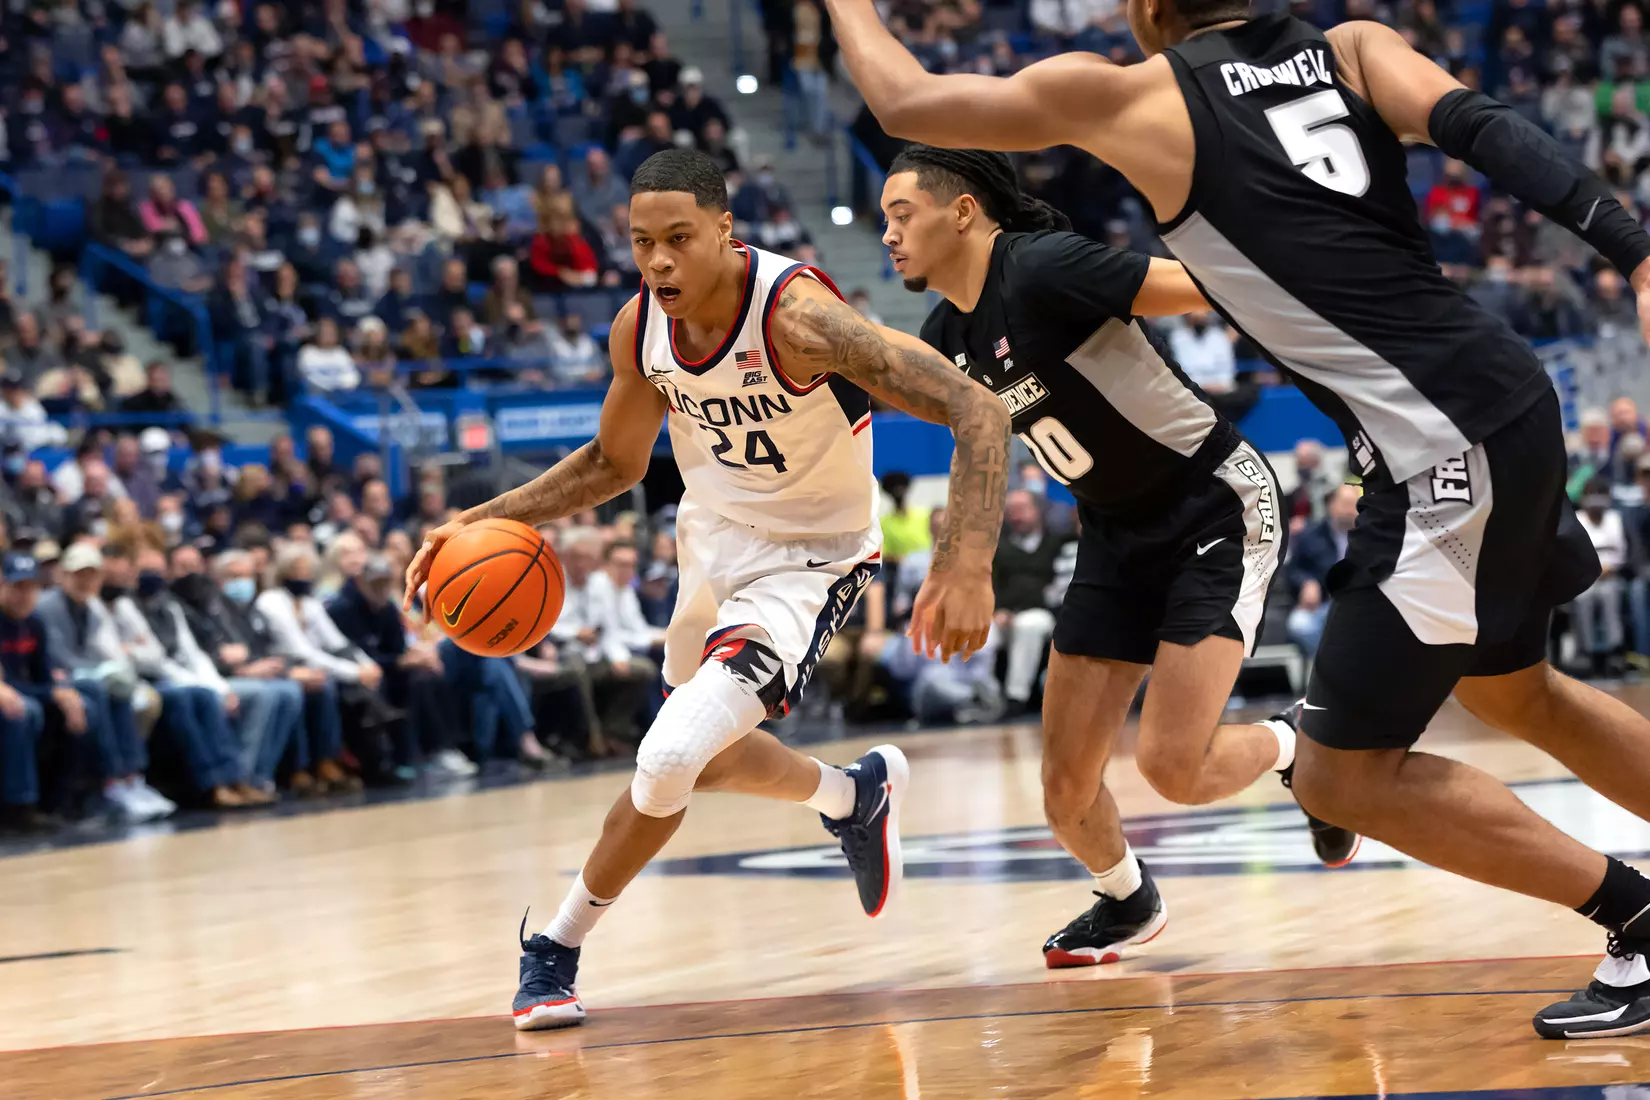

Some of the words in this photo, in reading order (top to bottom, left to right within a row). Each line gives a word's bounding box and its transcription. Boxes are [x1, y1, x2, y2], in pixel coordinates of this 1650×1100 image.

[1263, 89, 1371, 197] 5
[742, 376, 768, 386] EAST
[998, 376, 1047, 415] DENCE
[661, 385, 792, 427] UCONN
[699, 423, 788, 473] 24
[1235, 459, 1274, 544] FRIARS
